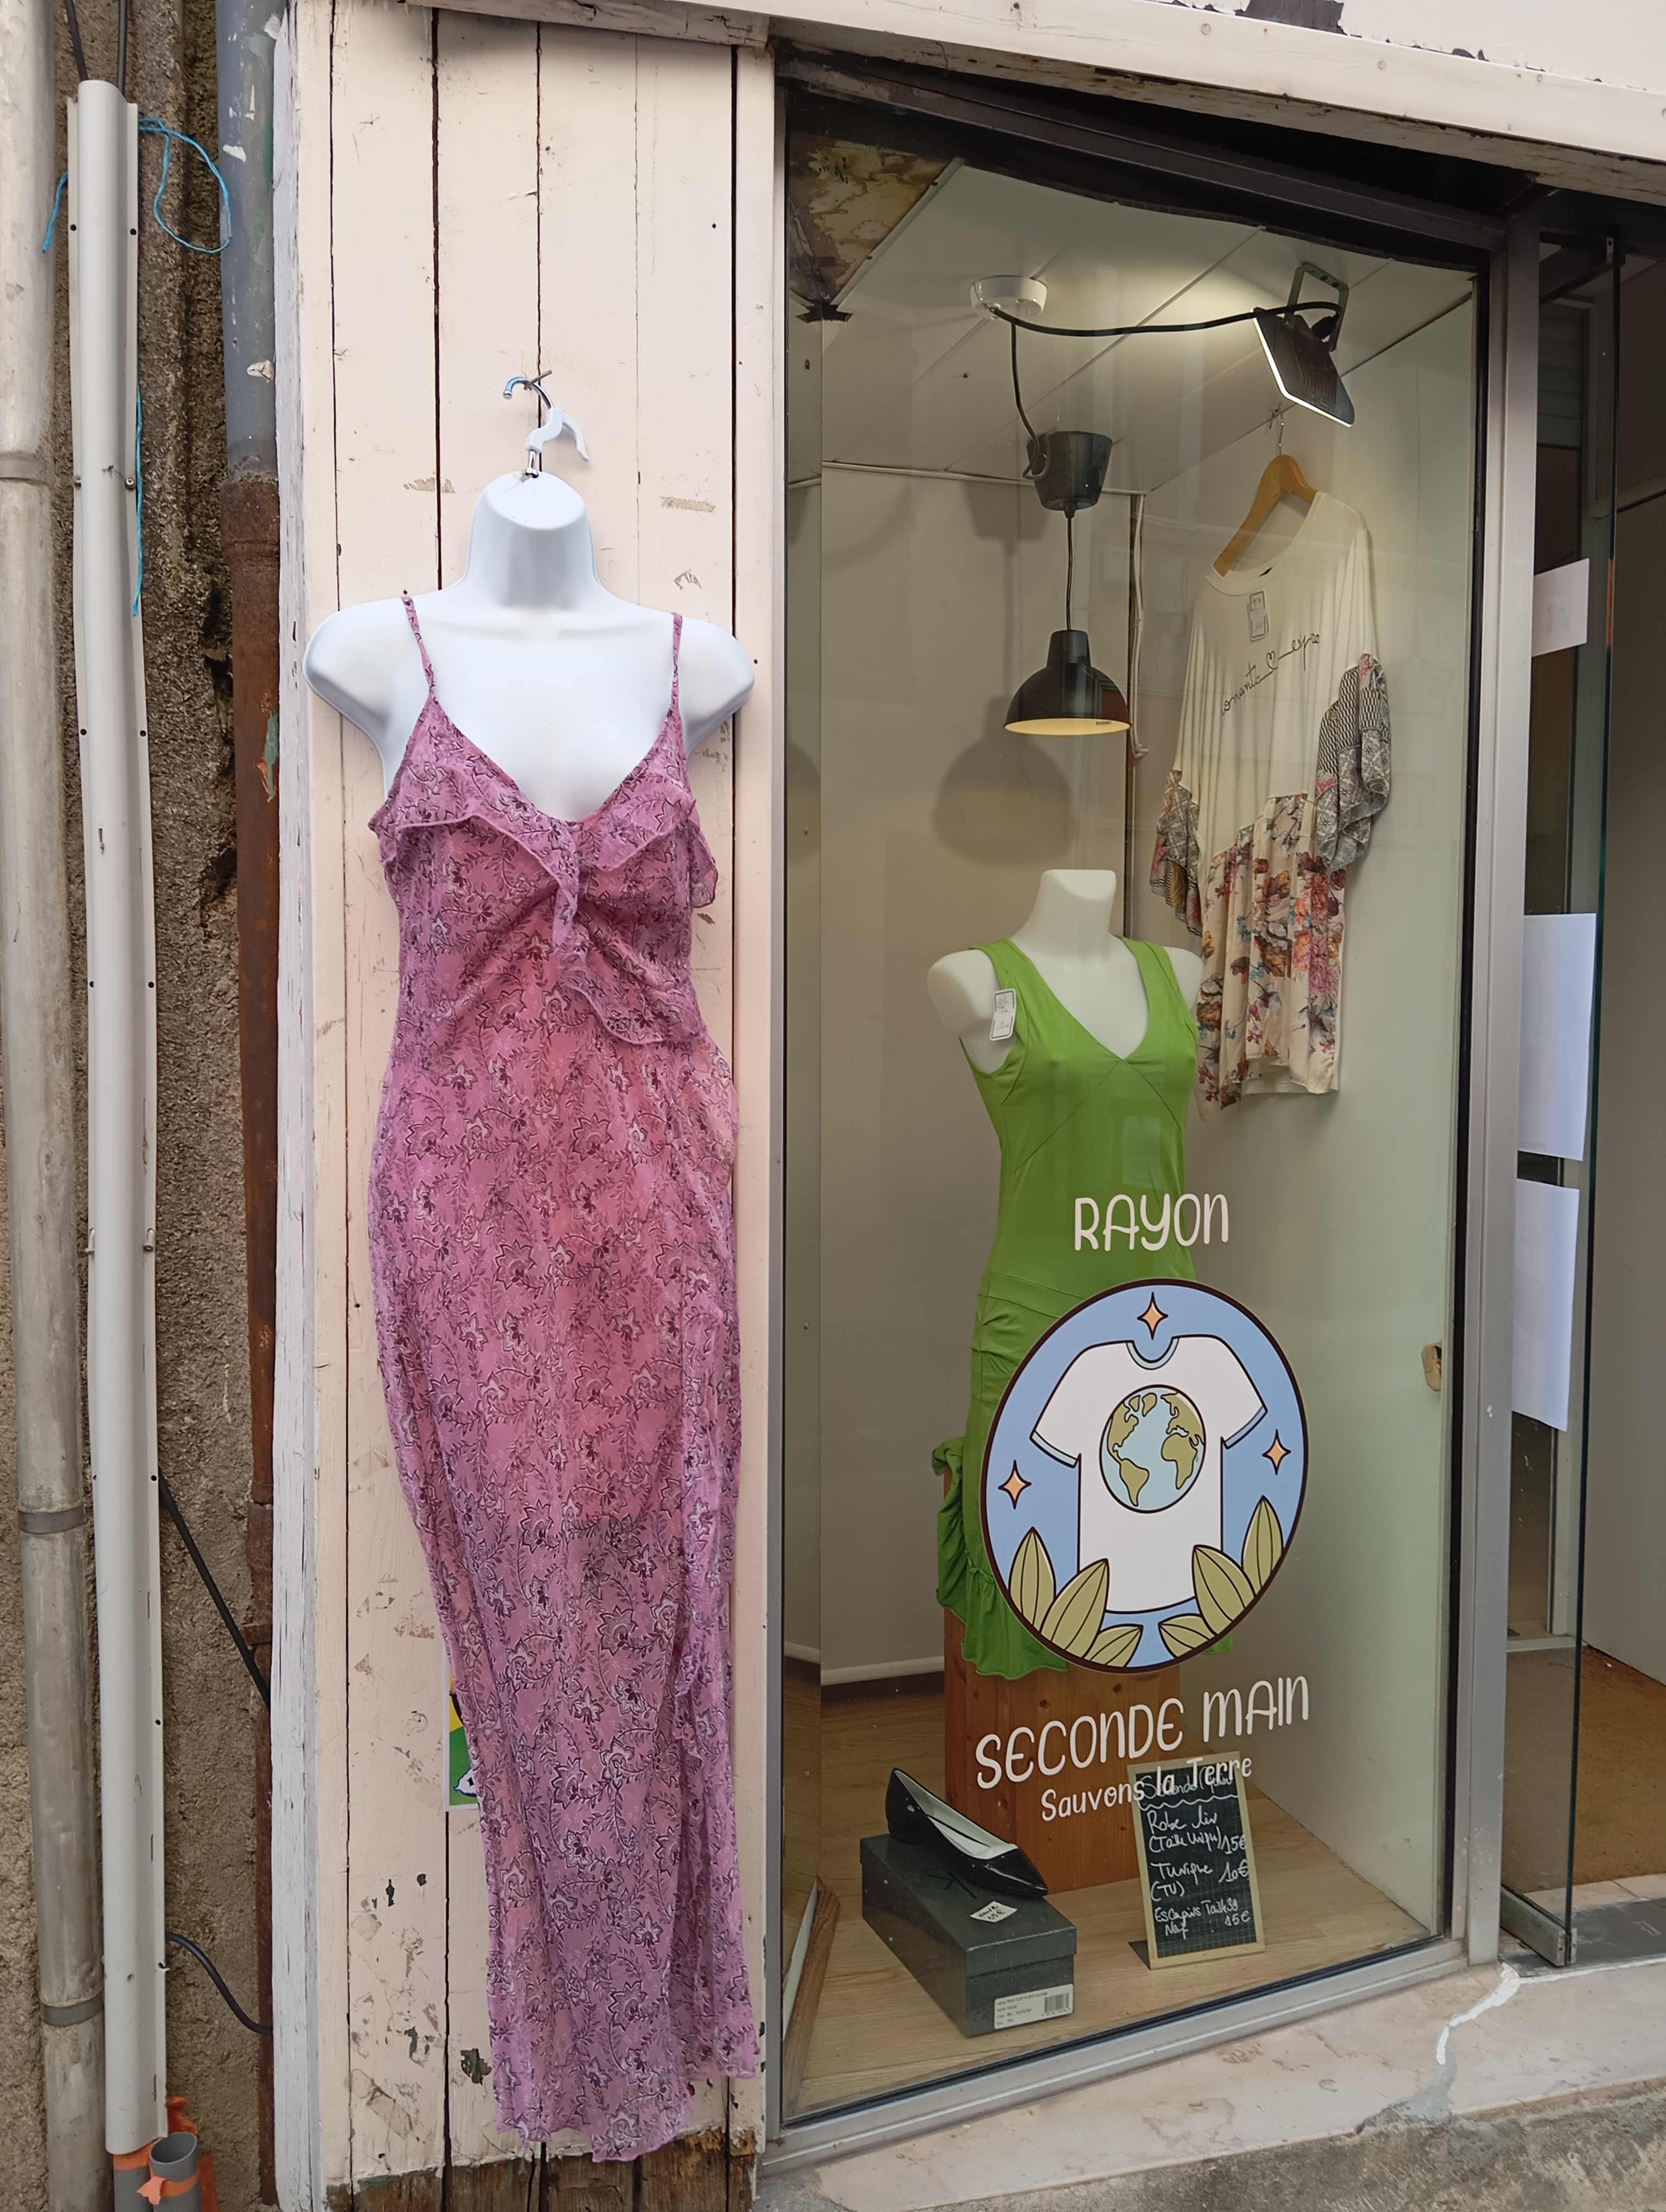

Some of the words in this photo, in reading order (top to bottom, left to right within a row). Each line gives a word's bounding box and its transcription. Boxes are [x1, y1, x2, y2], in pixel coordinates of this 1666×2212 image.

[1074, 1193, 1229, 1251] RAYON
[976, 1697, 1184, 1789] SECONDE
[1202, 1675, 1309, 1742] MAIN
[1041, 1780, 1145, 1822] Sauvons
[1156, 1765, 1175, 1796] la
[1186, 1757, 1252, 1789] Terre
[1146, 1810, 1187, 1835] Robe
[1150, 1862, 1213, 1886] Tunique
[1218, 1859, 1249, 1883] 10€
[1150, 1880, 1185, 1902] (TU)
[1224, 1909, 1251, 1926] 15€
